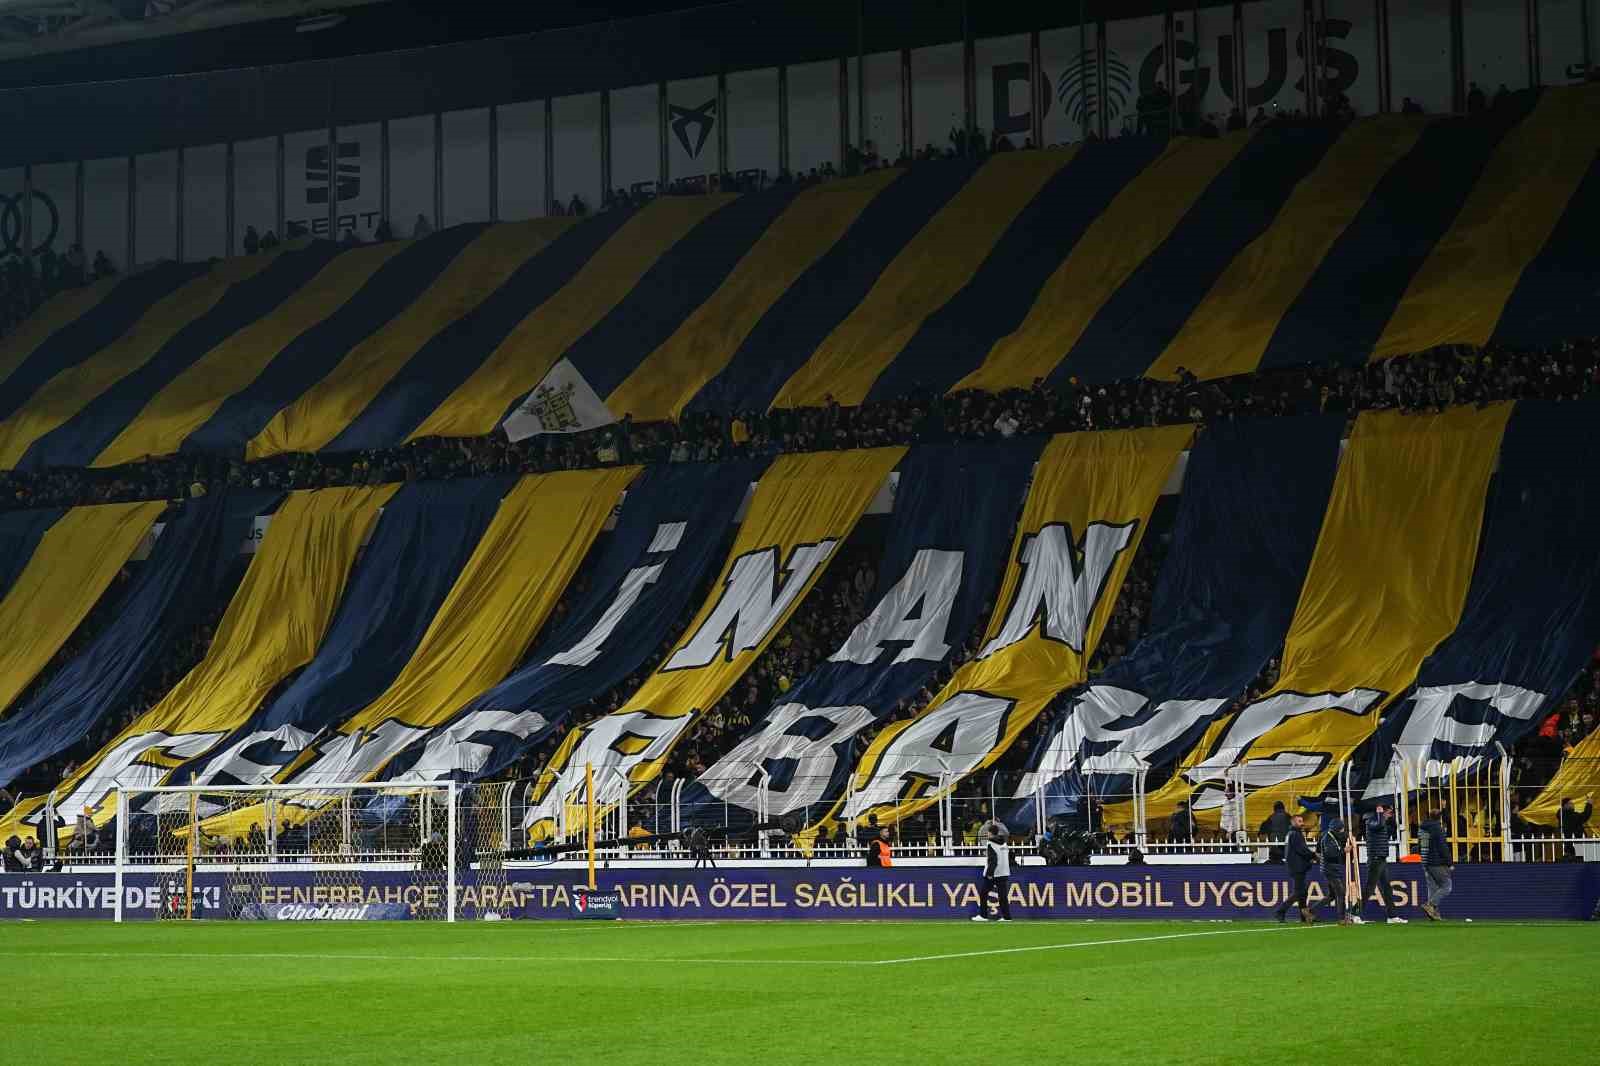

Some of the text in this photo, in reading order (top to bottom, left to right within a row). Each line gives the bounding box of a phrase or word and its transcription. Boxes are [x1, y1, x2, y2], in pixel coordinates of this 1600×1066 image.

[709, 878, 786, 908] ÖZEL
[795, 877, 933, 908] SAĞLIKLI
[1066, 876, 1173, 907] MOBİL
